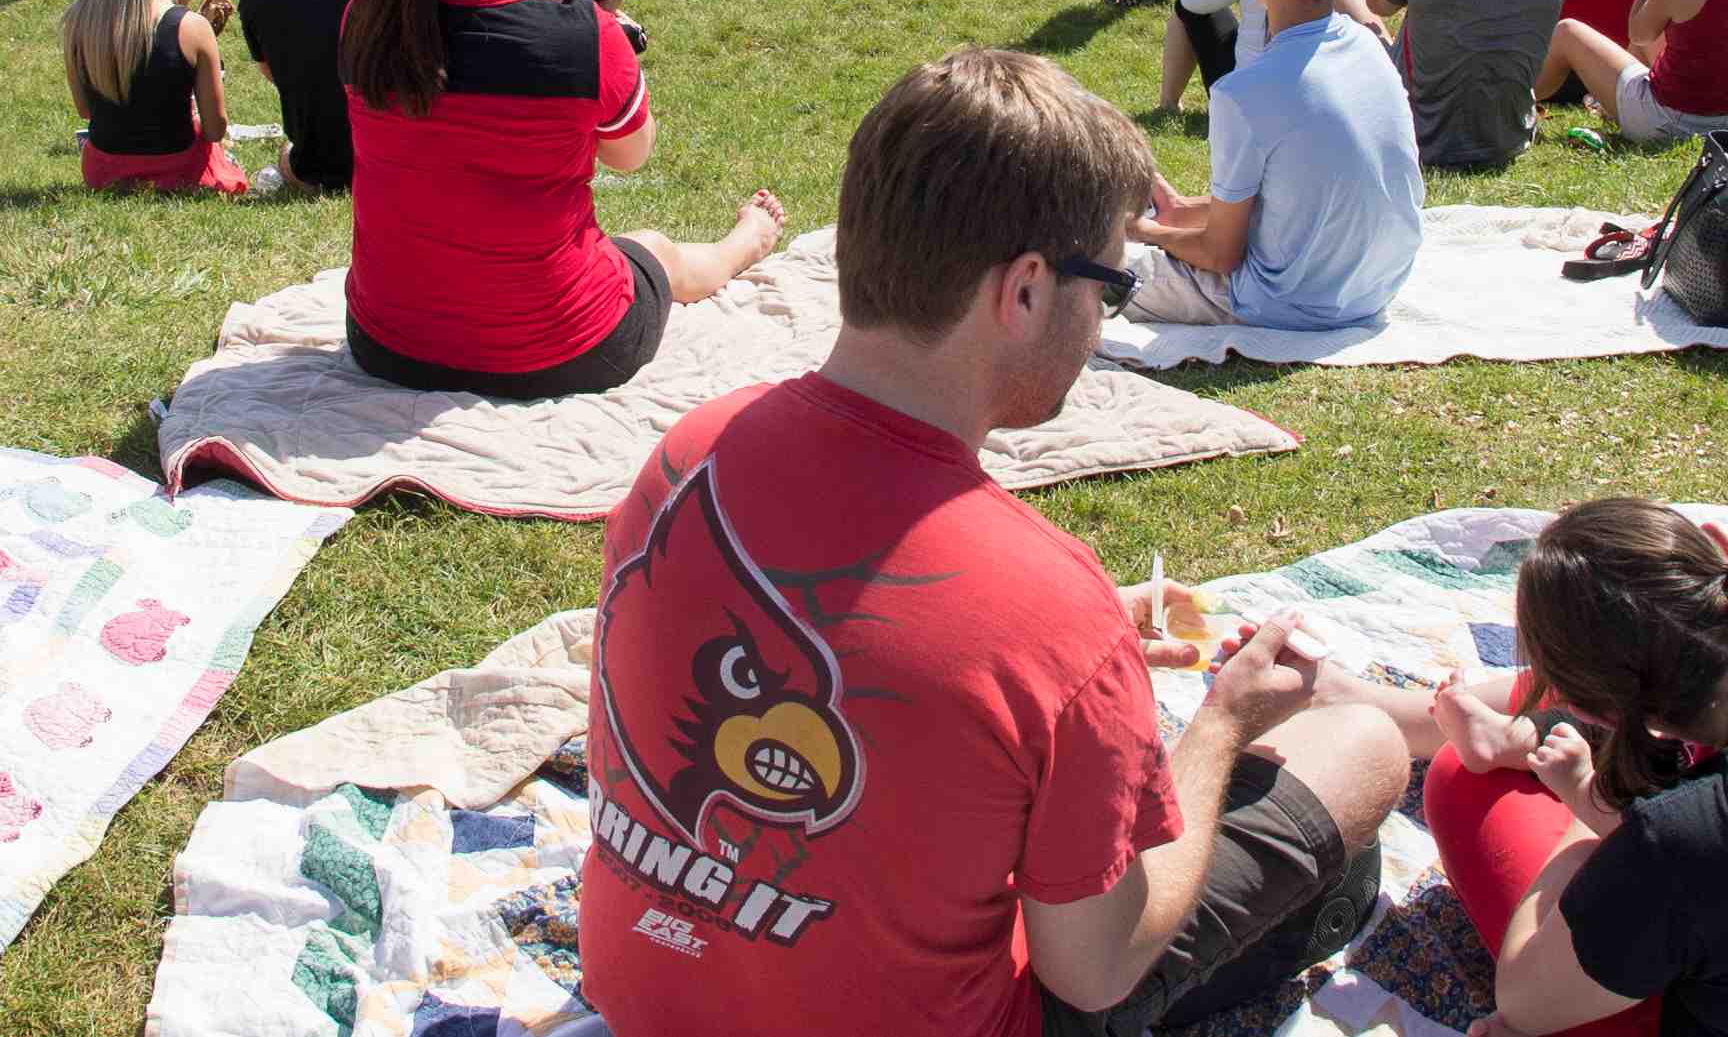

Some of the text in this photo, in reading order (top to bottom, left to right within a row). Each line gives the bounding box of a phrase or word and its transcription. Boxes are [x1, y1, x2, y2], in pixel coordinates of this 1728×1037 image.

[589, 776, 833, 941] BRING IT
[639, 919, 709, 950] EAST
[646, 908, 695, 931] BIG
